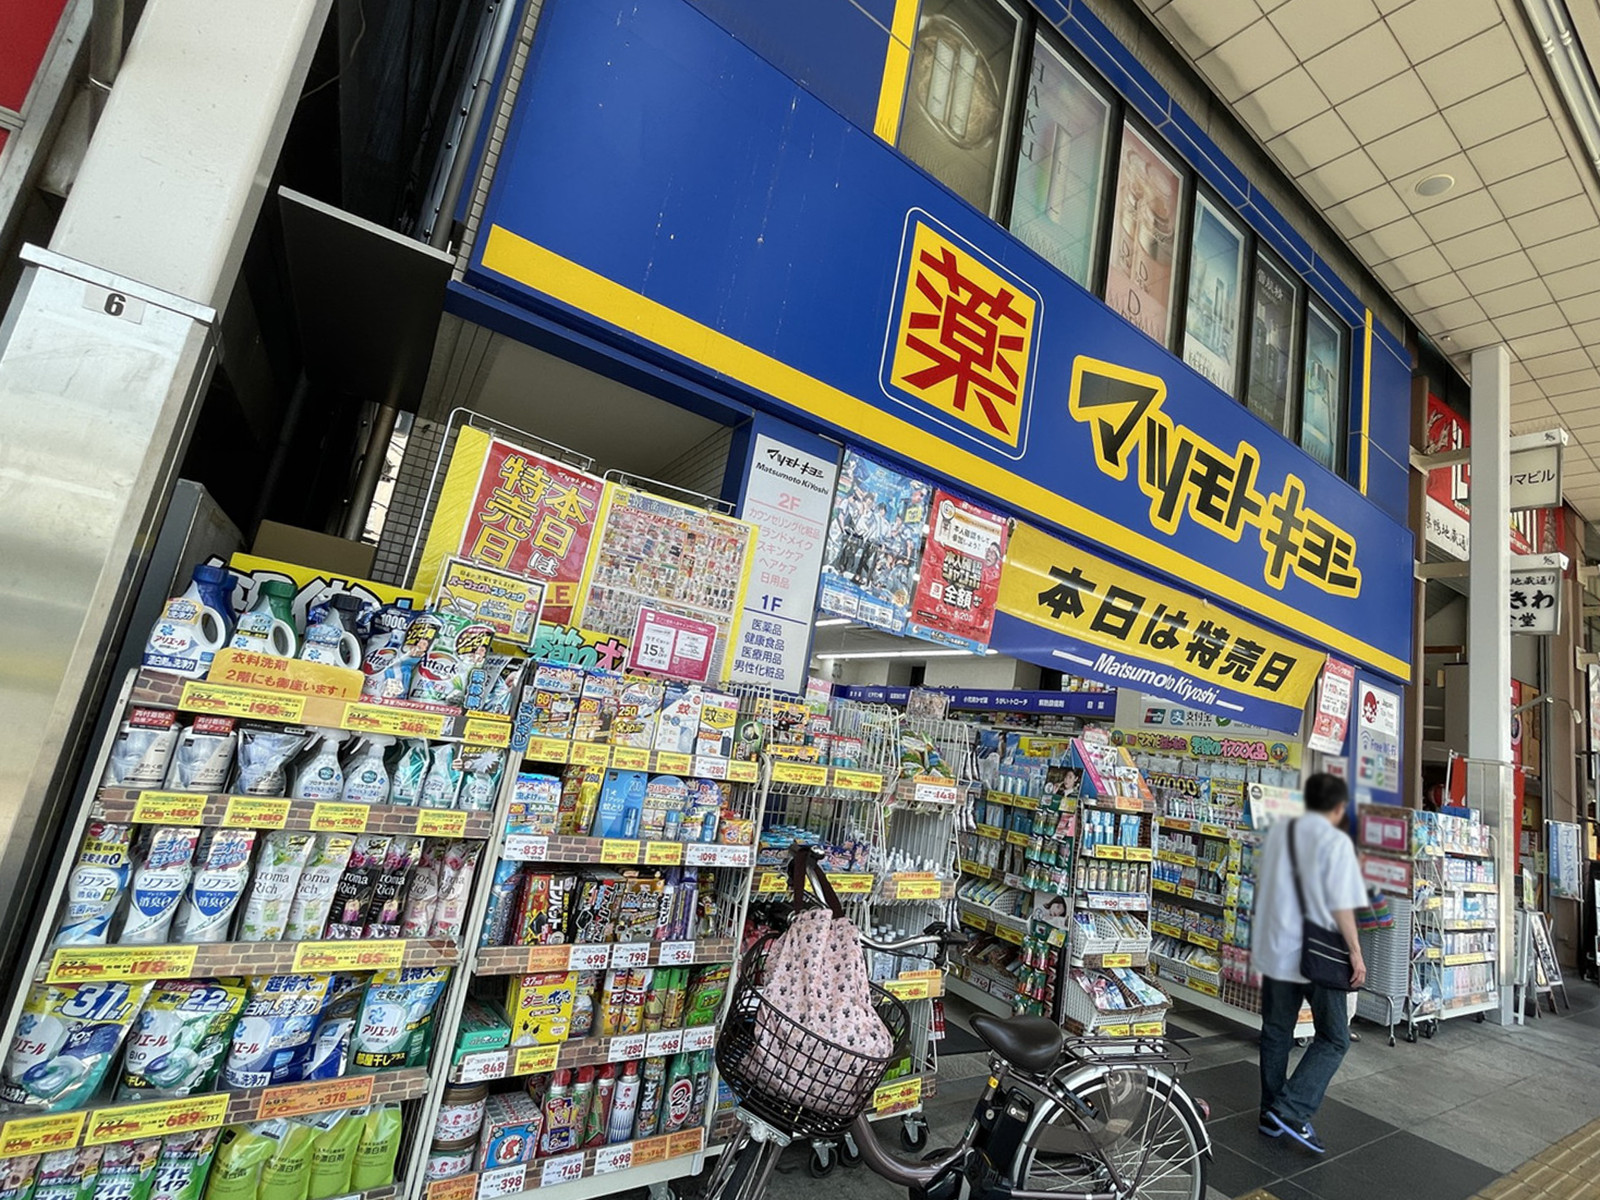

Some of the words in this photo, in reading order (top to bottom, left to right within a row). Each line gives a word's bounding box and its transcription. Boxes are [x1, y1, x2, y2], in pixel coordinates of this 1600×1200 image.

[1020, 56, 1045, 162] HAKU
[104, 293, 126, 316] 6
[901, 245, 1028, 437] 薬
[767, 449, 824, 478] マツモトキヨシ
[757, 462, 801, 485] Matsumoto
[1074, 364, 1360, 595] マツモトキヨシ
[778, 492, 801, 510] 2F
[471, 454, 552, 570] 特売日
[528, 484, 594, 577] 本日は
[749, 507, 820, 539] カウンセリング化粧品
[1426, 511, 1469, 551] 鴨地蔵通
[757, 541, 804, 562] スキンケア
[759, 558, 797, 575] ヘアケア
[760, 573, 790, 589] 日用品
[761, 594, 783, 612] 1F
[943, 585, 974, 611] 全額
[752, 619, 782, 636] 医薬品
[1510, 612, 1537, 628] 堂
[1037, 565, 1297, 692] 本日は特売日
[154, 635, 187, 647] アリエール
[744, 633, 785, 650] 健康食品
[232, 652, 289, 671] 衣料洗剤
[420, 651, 458, 675] Attack
[741, 647, 782, 665] 医療用品
[539, 666, 560, 677] アース
[734, 660, 784, 680] 男性化粧品
[1093, 653, 1174, 692] Matsumoto
[1173, 676, 1220, 707] Kiyoshi
[249, 702, 281, 714] 198
[399, 720, 425, 733] 348
[517, 781, 536, 791] アース
[523, 845, 545, 855] 833
[78, 875, 116, 887] ソフラン
[144, 877, 182, 888] ソフラン
[203, 877, 239, 889] ソフラン
[259, 871, 290, 883] roma
[299, 872, 331, 884] roma
[341, 872, 369, 885] roma
[380, 873, 406, 885] roma
[254, 881, 278, 894] Rich
[337, 882, 357, 895] Rich
[376, 883, 395, 896] Rich
[547, 878, 564, 930] コンバット
[357, 953, 384, 964] 185
[586, 954, 606, 964] 698
[629, 952, 647, 962] 798
[131, 961, 166, 973] 178
[362, 1024, 399, 1037] アリエール
[13, 1036, 47, 1056] リエール
[232, 1042, 260, 1054] エール
[661, 1039, 679, 1050] 668
[128, 1050, 147, 1060] BIO
[482, 1062, 505, 1074] 848
[324, 1092, 348, 1105] 378
[164, 1111, 201, 1128] 689
[612, 1152, 631, 1166] 698
[561, 1163, 582, 1176] 748
[500, 1175, 523, 1190] 398
